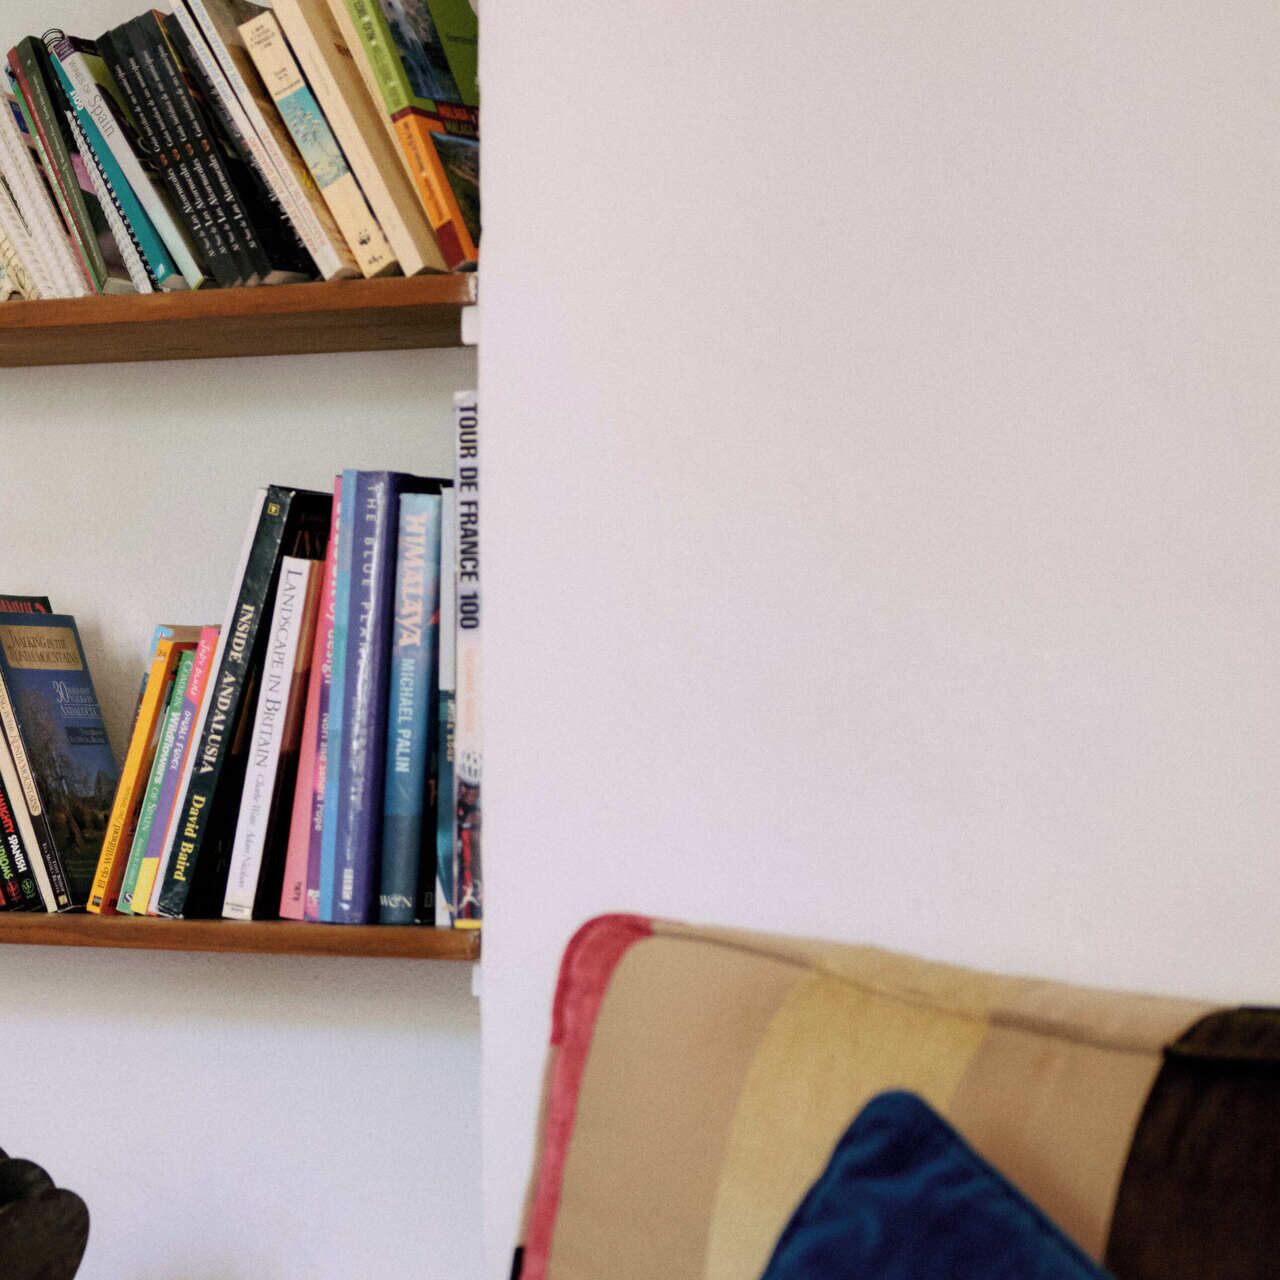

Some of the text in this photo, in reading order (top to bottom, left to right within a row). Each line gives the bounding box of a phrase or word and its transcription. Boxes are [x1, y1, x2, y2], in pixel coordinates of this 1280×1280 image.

[87, 91, 120, 140] Spain
[364, 484, 379, 522] THE
[459, 403, 479, 630] TOUR DE FRANCE 100
[361, 537, 376, 586] BLUE
[393, 510, 429, 648] HIMALAYA
[199, 603, 255, 773] INSIDE ANDALUSIA
[255, 569, 303, 767] LANDSCAPE IN BRITAIN
[153, 710, 181, 785] Wildflowers
[394, 658, 415, 773] MICHAEL PALIN
[6, 833, 28, 873] SPANISH
[172, 793, 207, 883] David Baird
